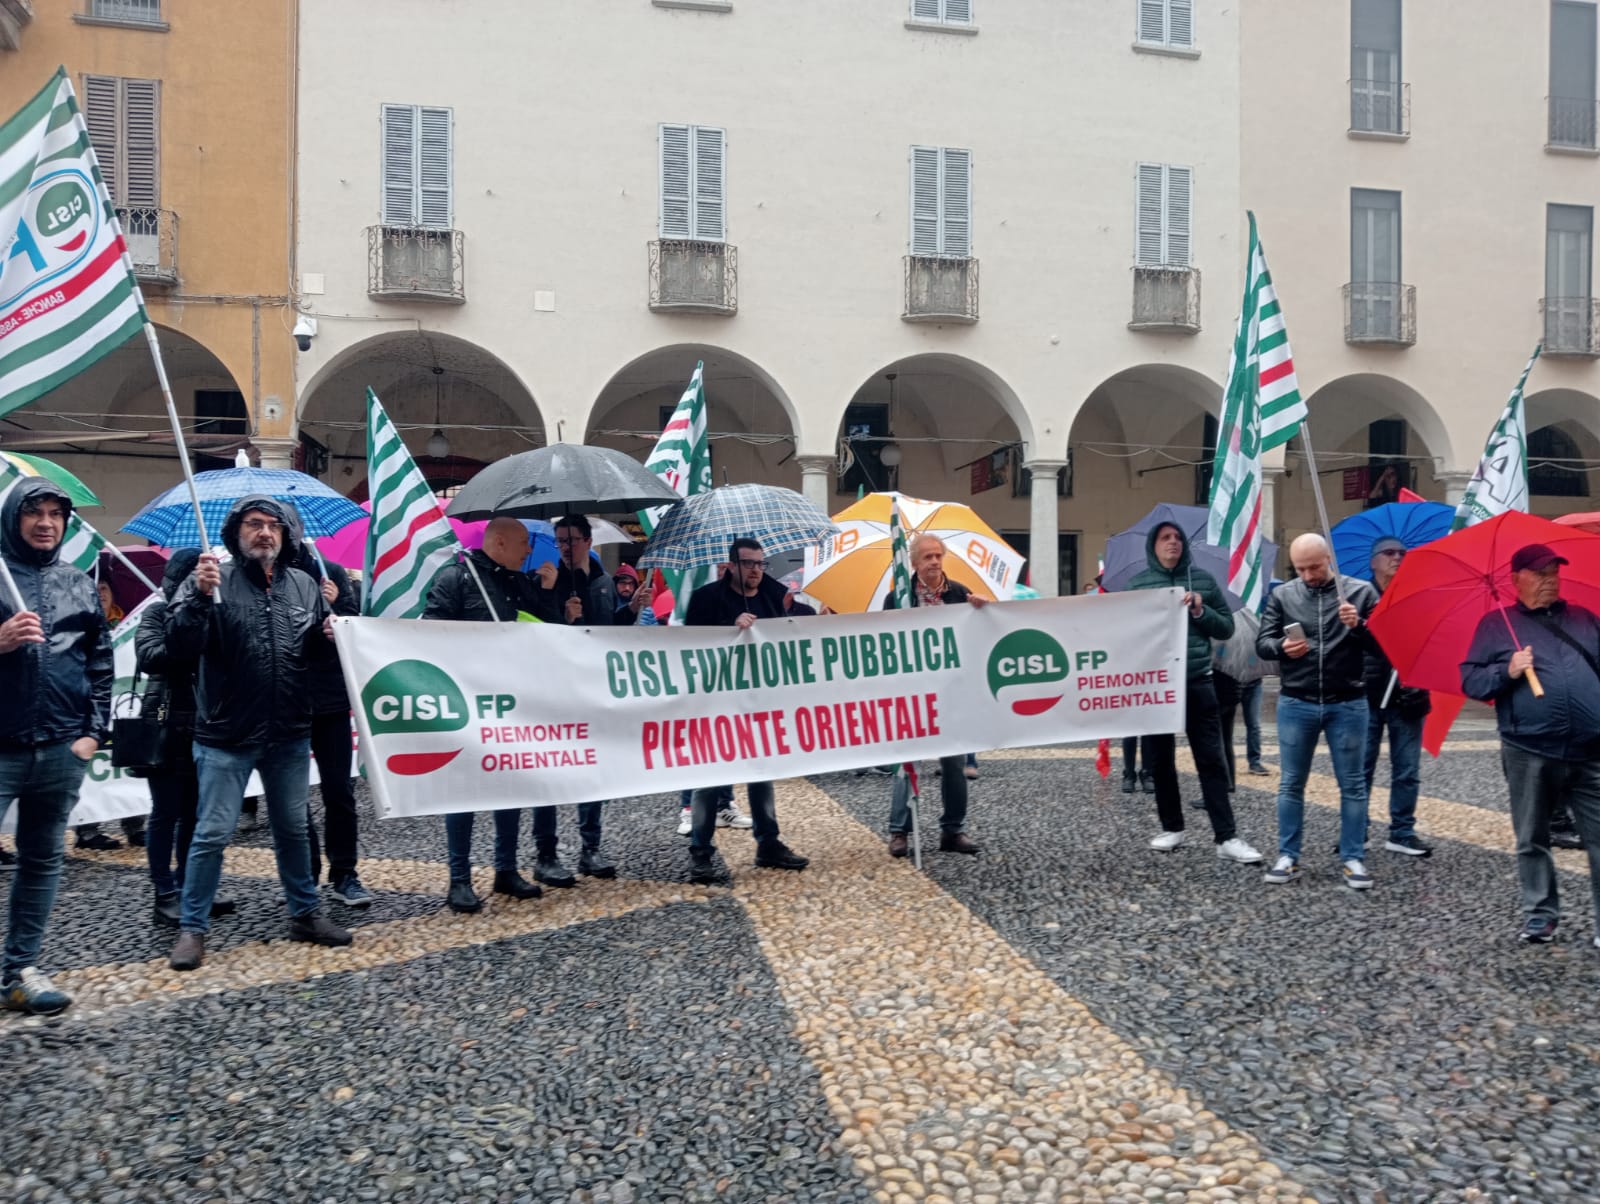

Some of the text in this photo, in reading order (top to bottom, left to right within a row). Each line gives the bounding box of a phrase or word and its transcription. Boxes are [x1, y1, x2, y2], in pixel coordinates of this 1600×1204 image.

[605, 626, 962, 699] CISL FUNZIONE PUBBLICA
[997, 653, 1062, 678] CISL
[1075, 650, 1109, 671] FP
[1077, 669, 1170, 691] PIEMONTE
[372, 693, 460, 721] CISL
[475, 693, 517, 719] FP
[1078, 689, 1177, 712] ORIENTALE
[480, 722, 590, 745] PIEMONTE
[641, 692, 941, 771] PIEMONTE ORIENTALE
[481, 748, 598, 773] ORIENTALE
